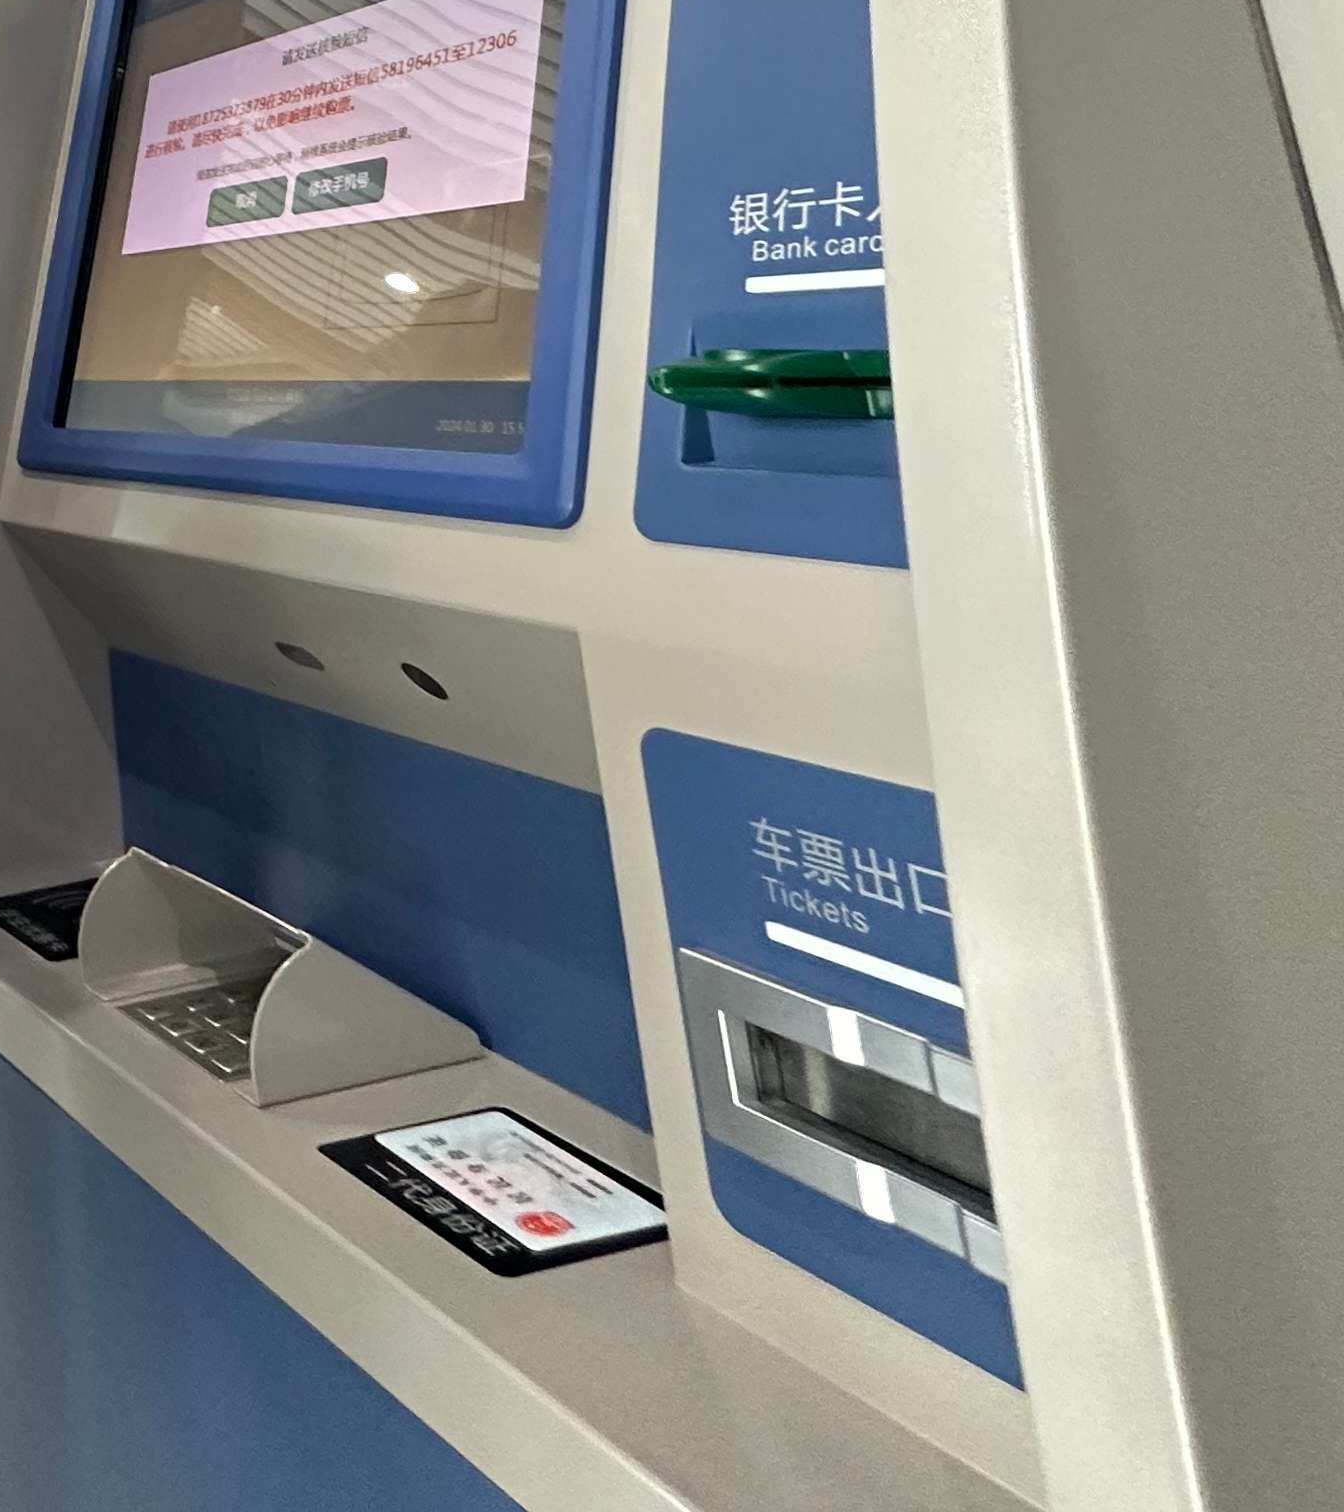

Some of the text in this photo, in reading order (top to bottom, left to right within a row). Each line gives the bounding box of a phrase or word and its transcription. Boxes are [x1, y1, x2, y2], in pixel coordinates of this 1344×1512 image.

[752, 235, 817, 262] Bank
[749, 816, 953, 919] 车票出口
[760, 874, 871, 935] Tickets
